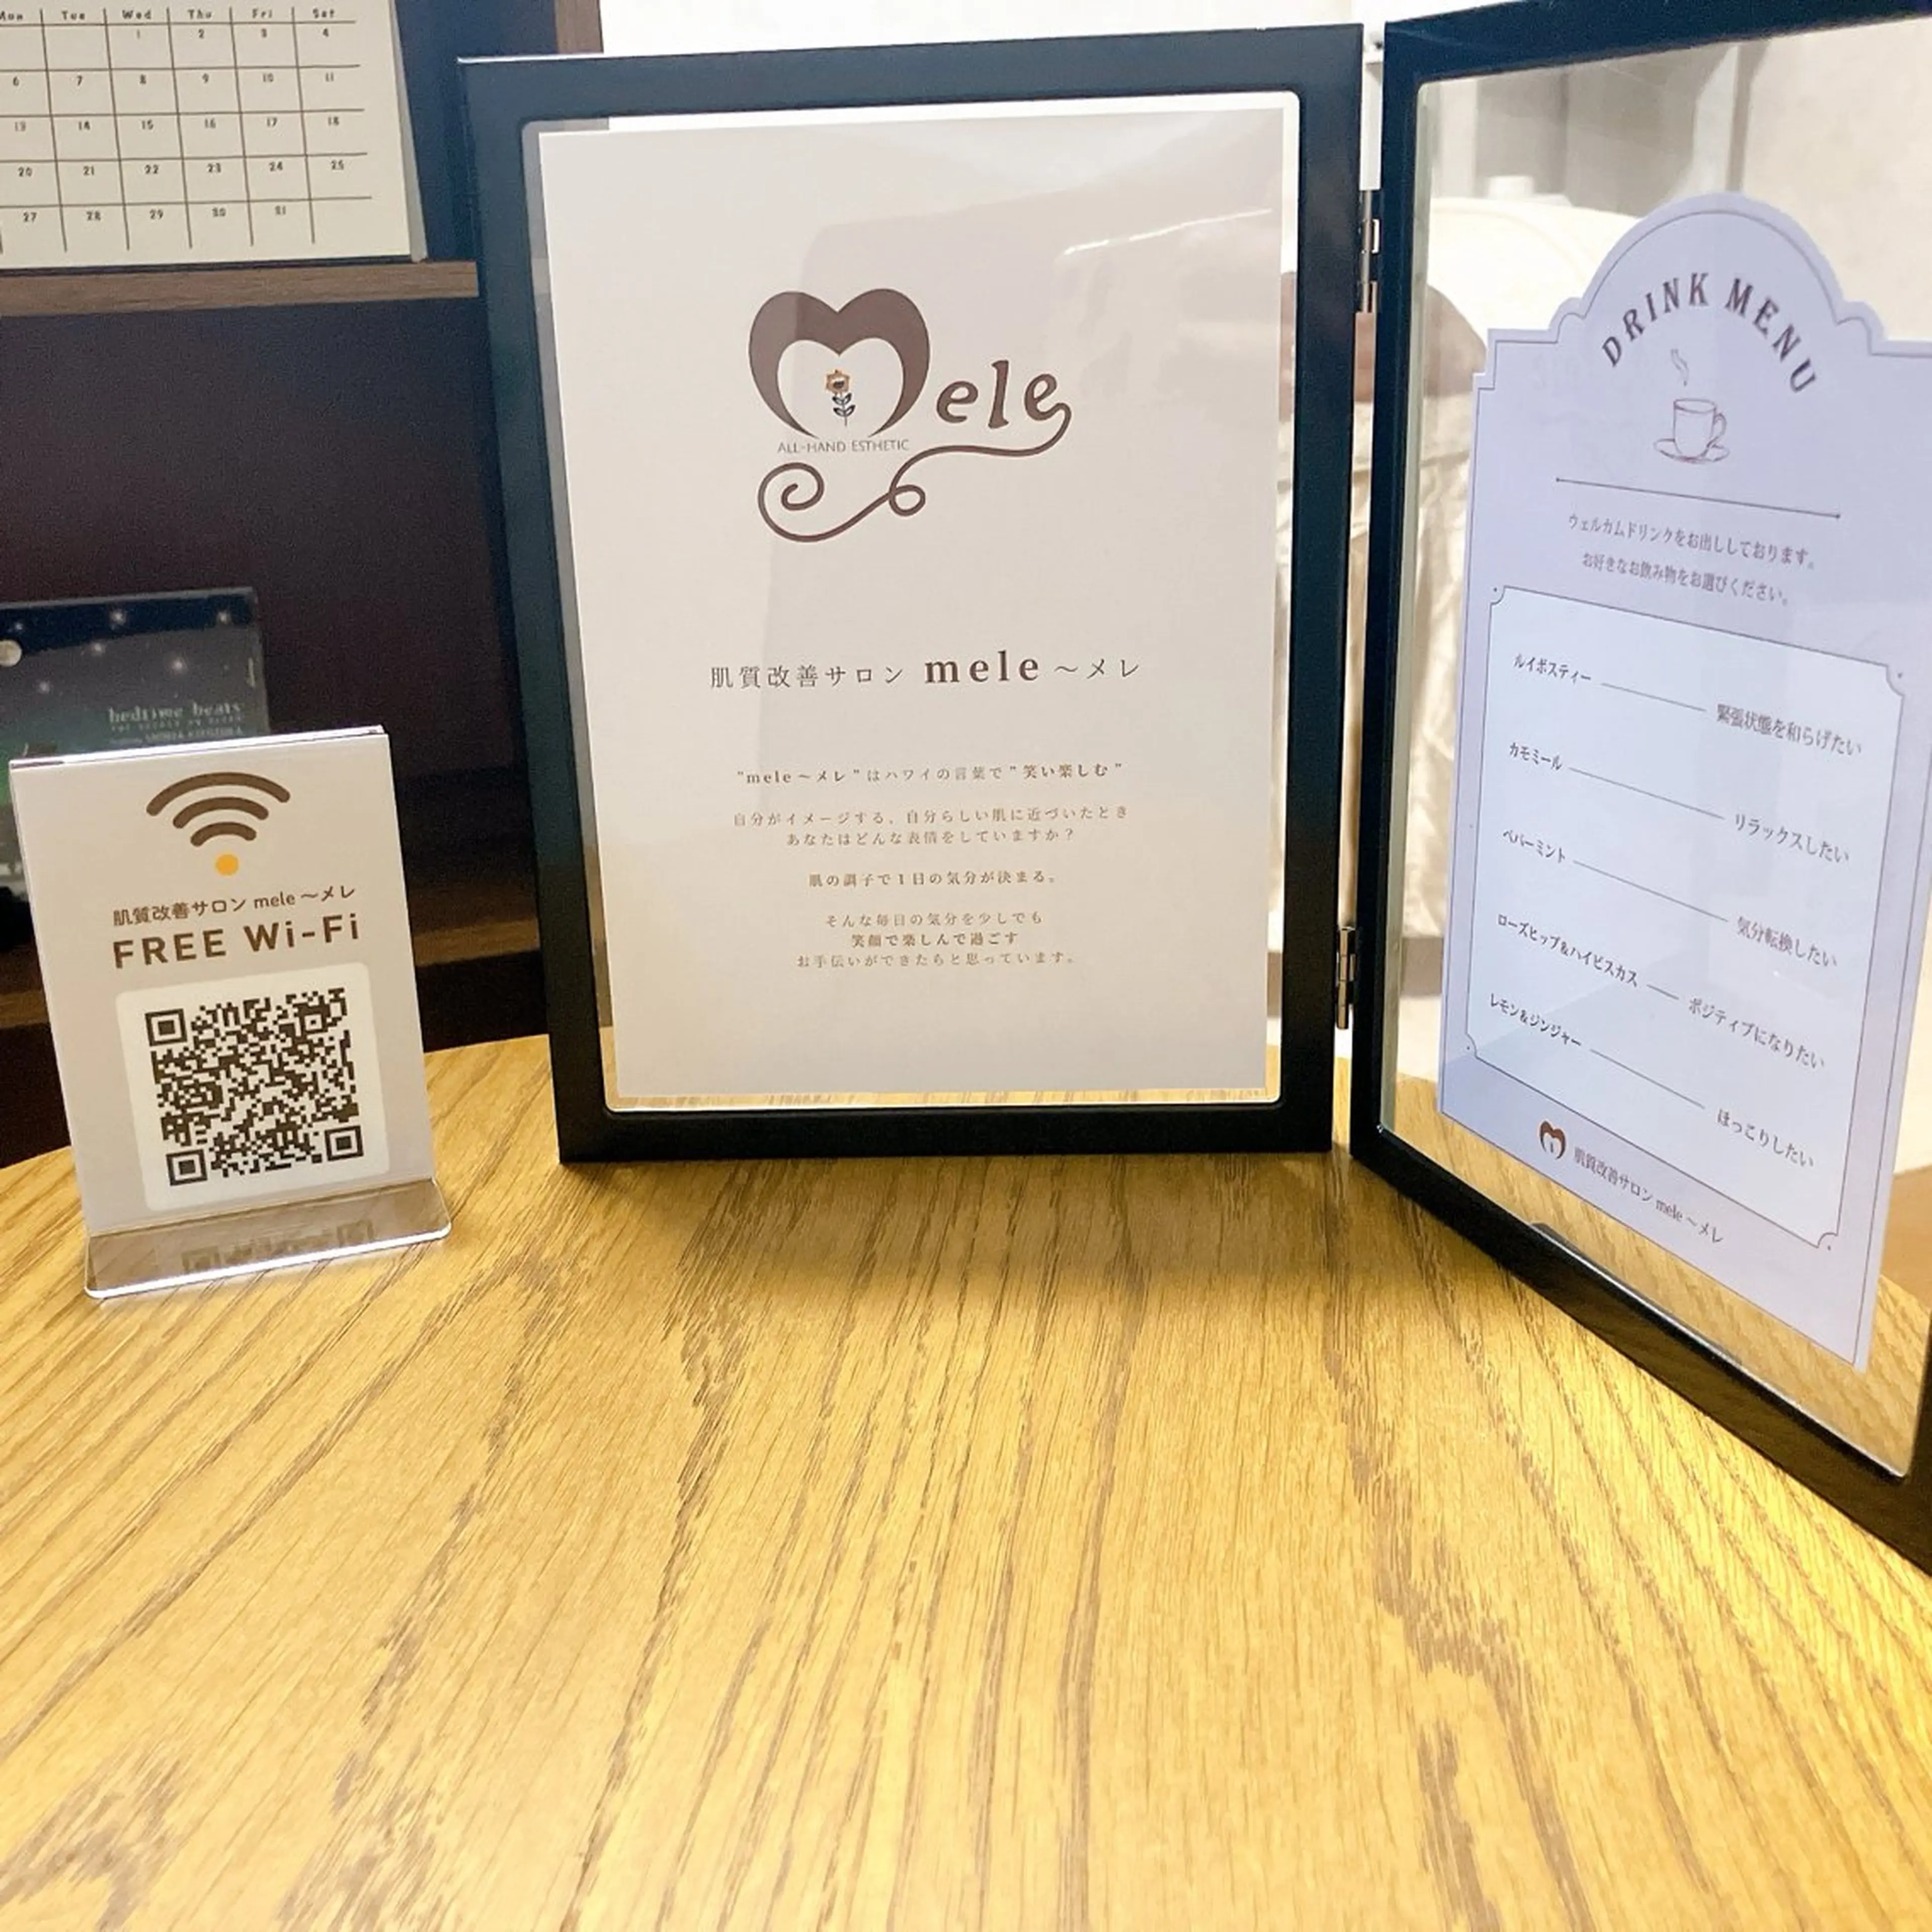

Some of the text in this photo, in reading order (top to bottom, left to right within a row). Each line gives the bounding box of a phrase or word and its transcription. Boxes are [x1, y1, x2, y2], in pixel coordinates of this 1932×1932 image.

[61, 11, 85, 20] Tue
[122, 10, 151, 19] Wed
[188, 9, 211, 19] Thu
[252, 8, 272, 19] Fri
[312, 8, 334, 19] Sat
[198, 29, 204, 39] 2
[261, 28, 267, 38] 3
[323, 28, 329, 37] 4
[13, 72, 334, 86] 6 7 8 9 10 11
[15, 116, 339, 131] 13 14 15 16 17 18
[18, 159, 344, 177] 20 21 22 23 24 25
[1601, 272, 1816, 393] DRINK MENU
[777, 439, 909, 453] ALL-HAND ESTHETIC
[1582, 552, 1788, 605] お好きなお飲み物をお選びください。
[1514, 654, 1861, 755] ルイボスティー 緊張状態を和らげたい
[1510, 742, 1849, 863] カモミール リラックスしたい
[113, 913, 359, 969] FREE Wi-Fi
[1737, 916, 1836, 967] 気分転換したい
[1498, 914, 1824, 1069] ローズヒップ&ハイビスカス ポジティブになりたい
[1491, 993, 1813, 1167] レモン&ジンジャー ほっこりしたい
